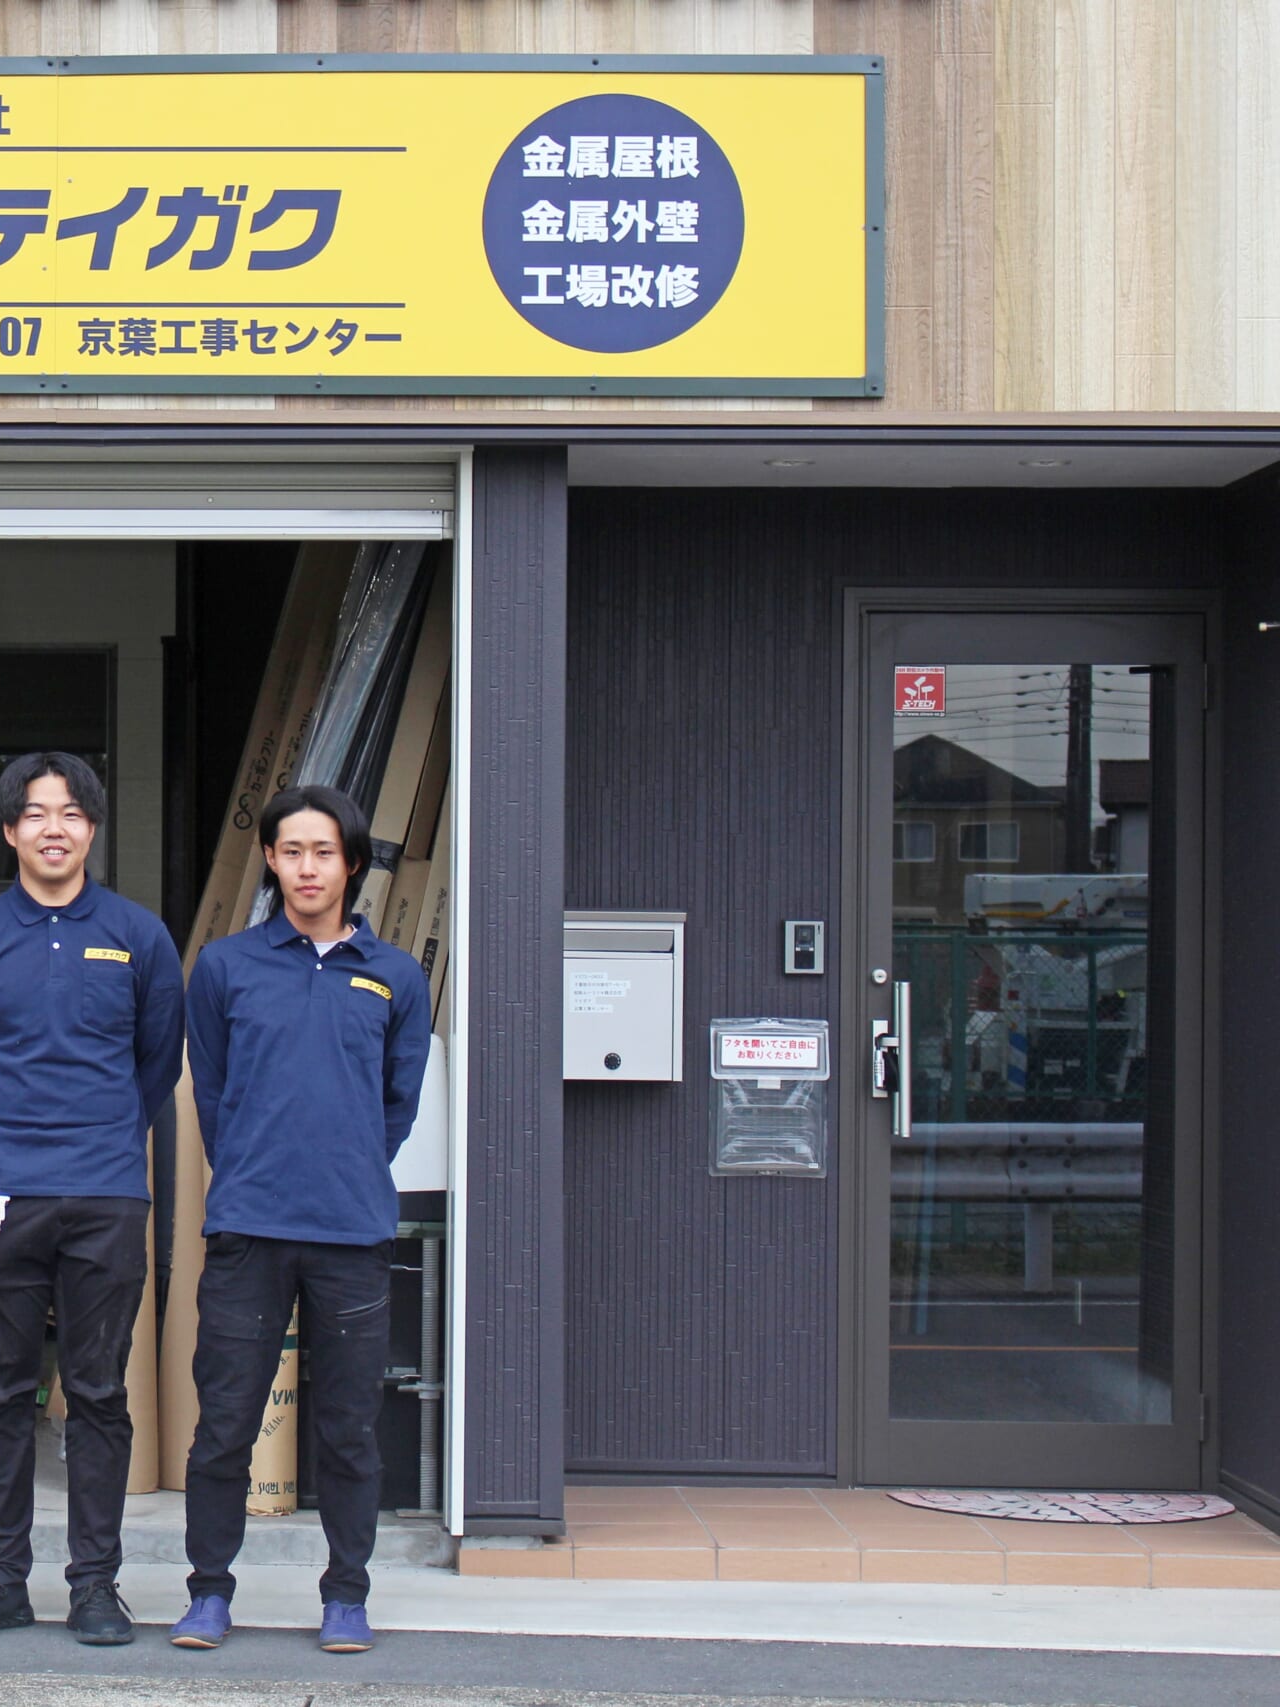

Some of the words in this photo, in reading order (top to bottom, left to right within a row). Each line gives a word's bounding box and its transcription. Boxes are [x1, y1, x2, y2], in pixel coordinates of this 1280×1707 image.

[522, 135, 700, 179] 金属屋根
[522, 199, 700, 243] 金属外壁
[521, 264, 700, 308] 工場改修
[77, 317, 402, 357] 京葉工事センター
[724, 1038, 816, 1050] フタを開いてご自由に
[737, 1049, 802, 1060] お取りください
